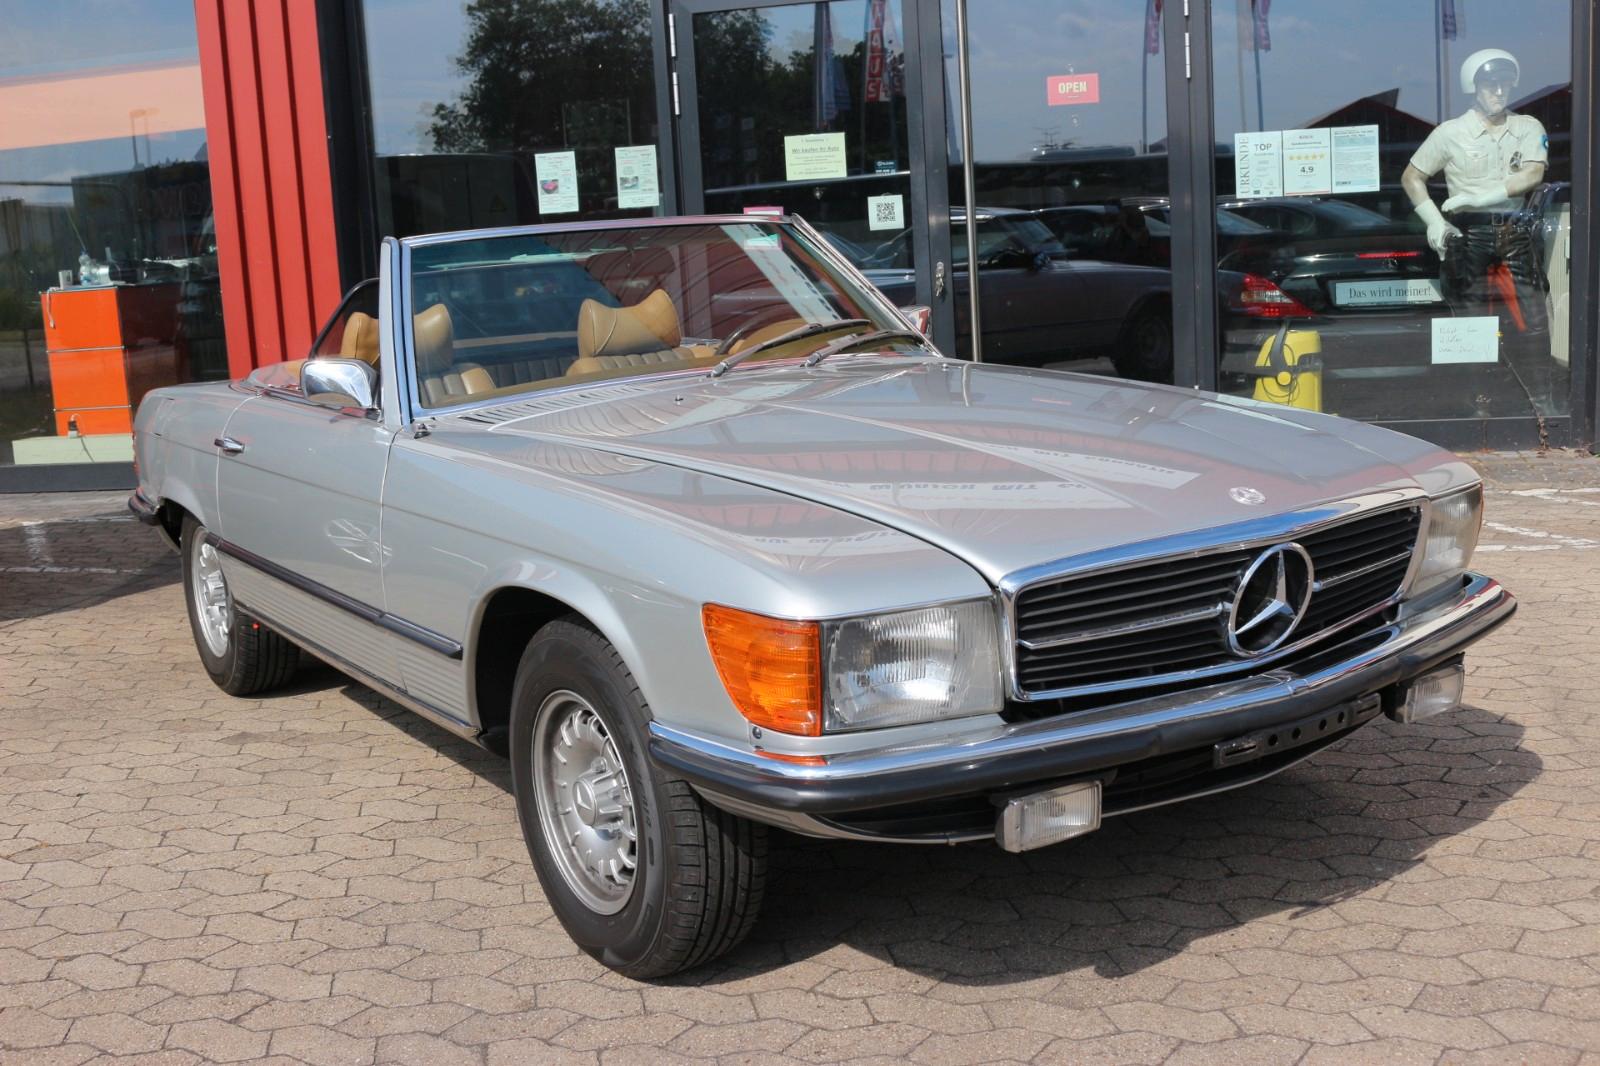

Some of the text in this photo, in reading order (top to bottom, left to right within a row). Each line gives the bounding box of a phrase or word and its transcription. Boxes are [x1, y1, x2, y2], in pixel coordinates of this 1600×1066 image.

[1058, 80, 1088, 94] OPEN
[1253, 143, 1272, 151] TOP
[1239, 136, 1250, 194] URKUNDE
[1349, 286, 1431, 299] Das wird meiner!
